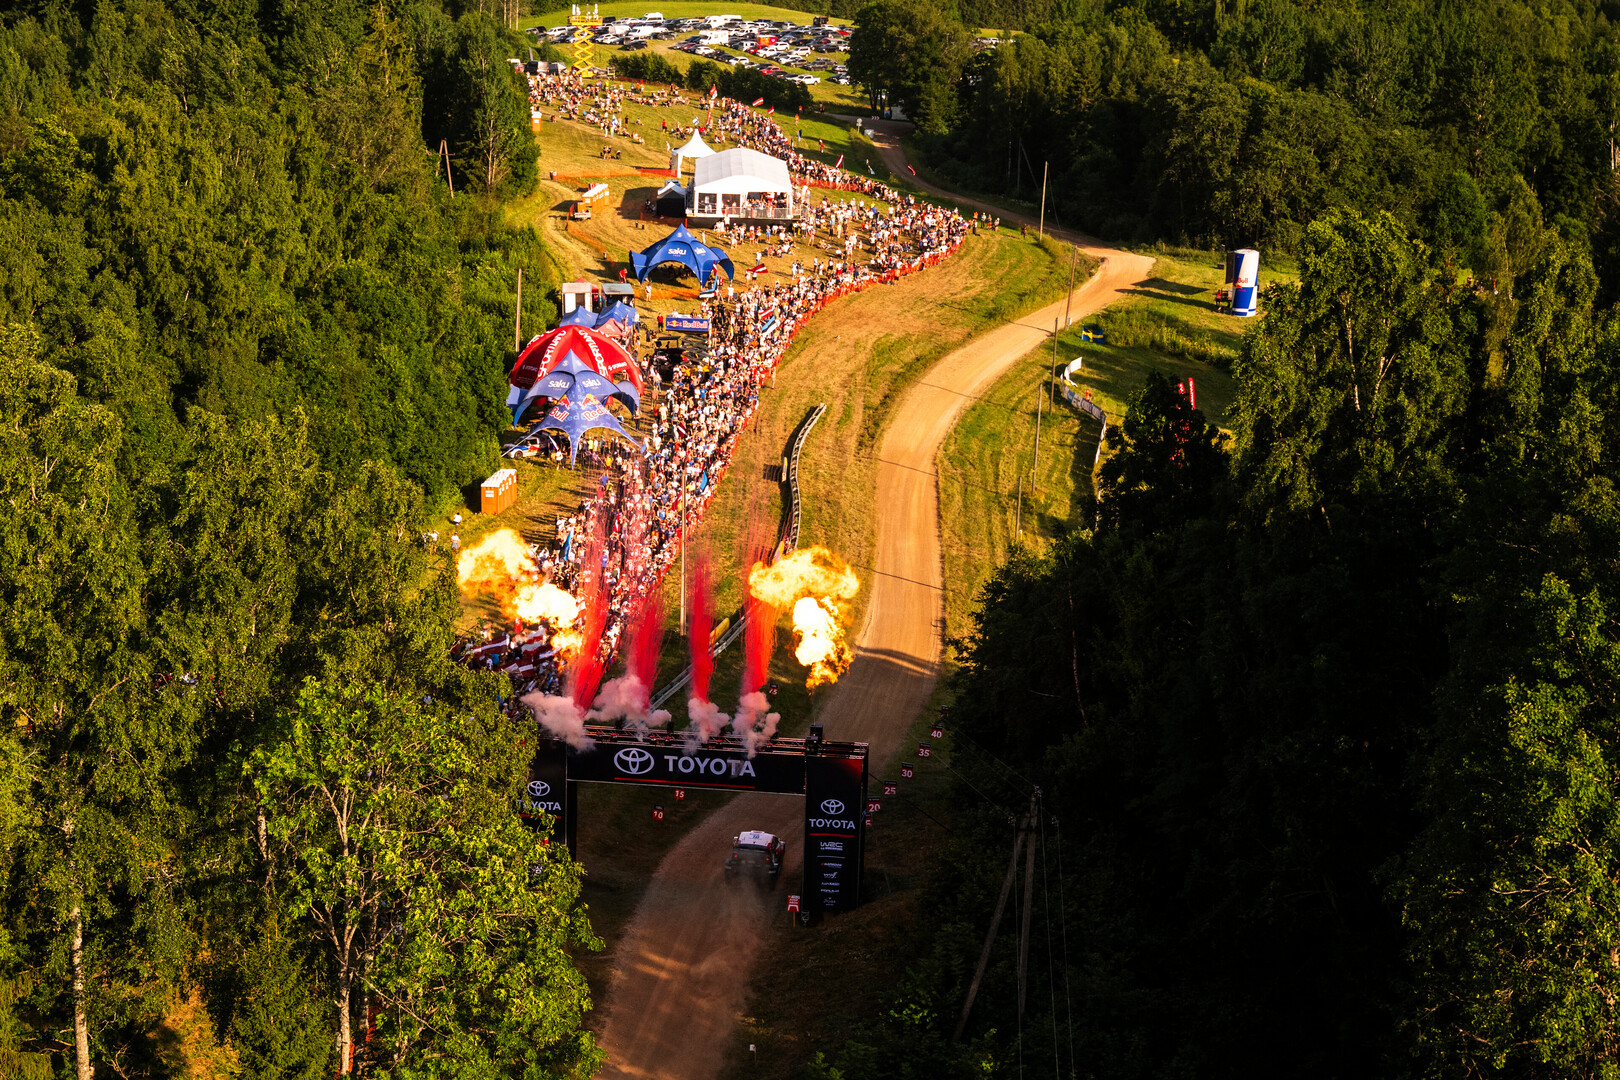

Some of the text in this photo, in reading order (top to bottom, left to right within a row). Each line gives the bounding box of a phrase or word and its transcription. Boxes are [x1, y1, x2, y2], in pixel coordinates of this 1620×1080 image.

[548, 379, 570, 388] saku
[582, 378, 602, 388] saku
[549, 406, 570, 422] Bull
[583, 406, 604, 421] Red
[931, 730, 942, 738] 40
[918, 748, 930, 757] 35
[664, 755, 757, 778] TOYOTA
[902, 769, 913, 778] 30
[676, 790, 685, 798] 15
[884, 786, 896, 794] 25
[868, 804, 880, 812] 20
[653, 810, 664, 819] 10
[808, 818, 856, 830] TOYOTA
